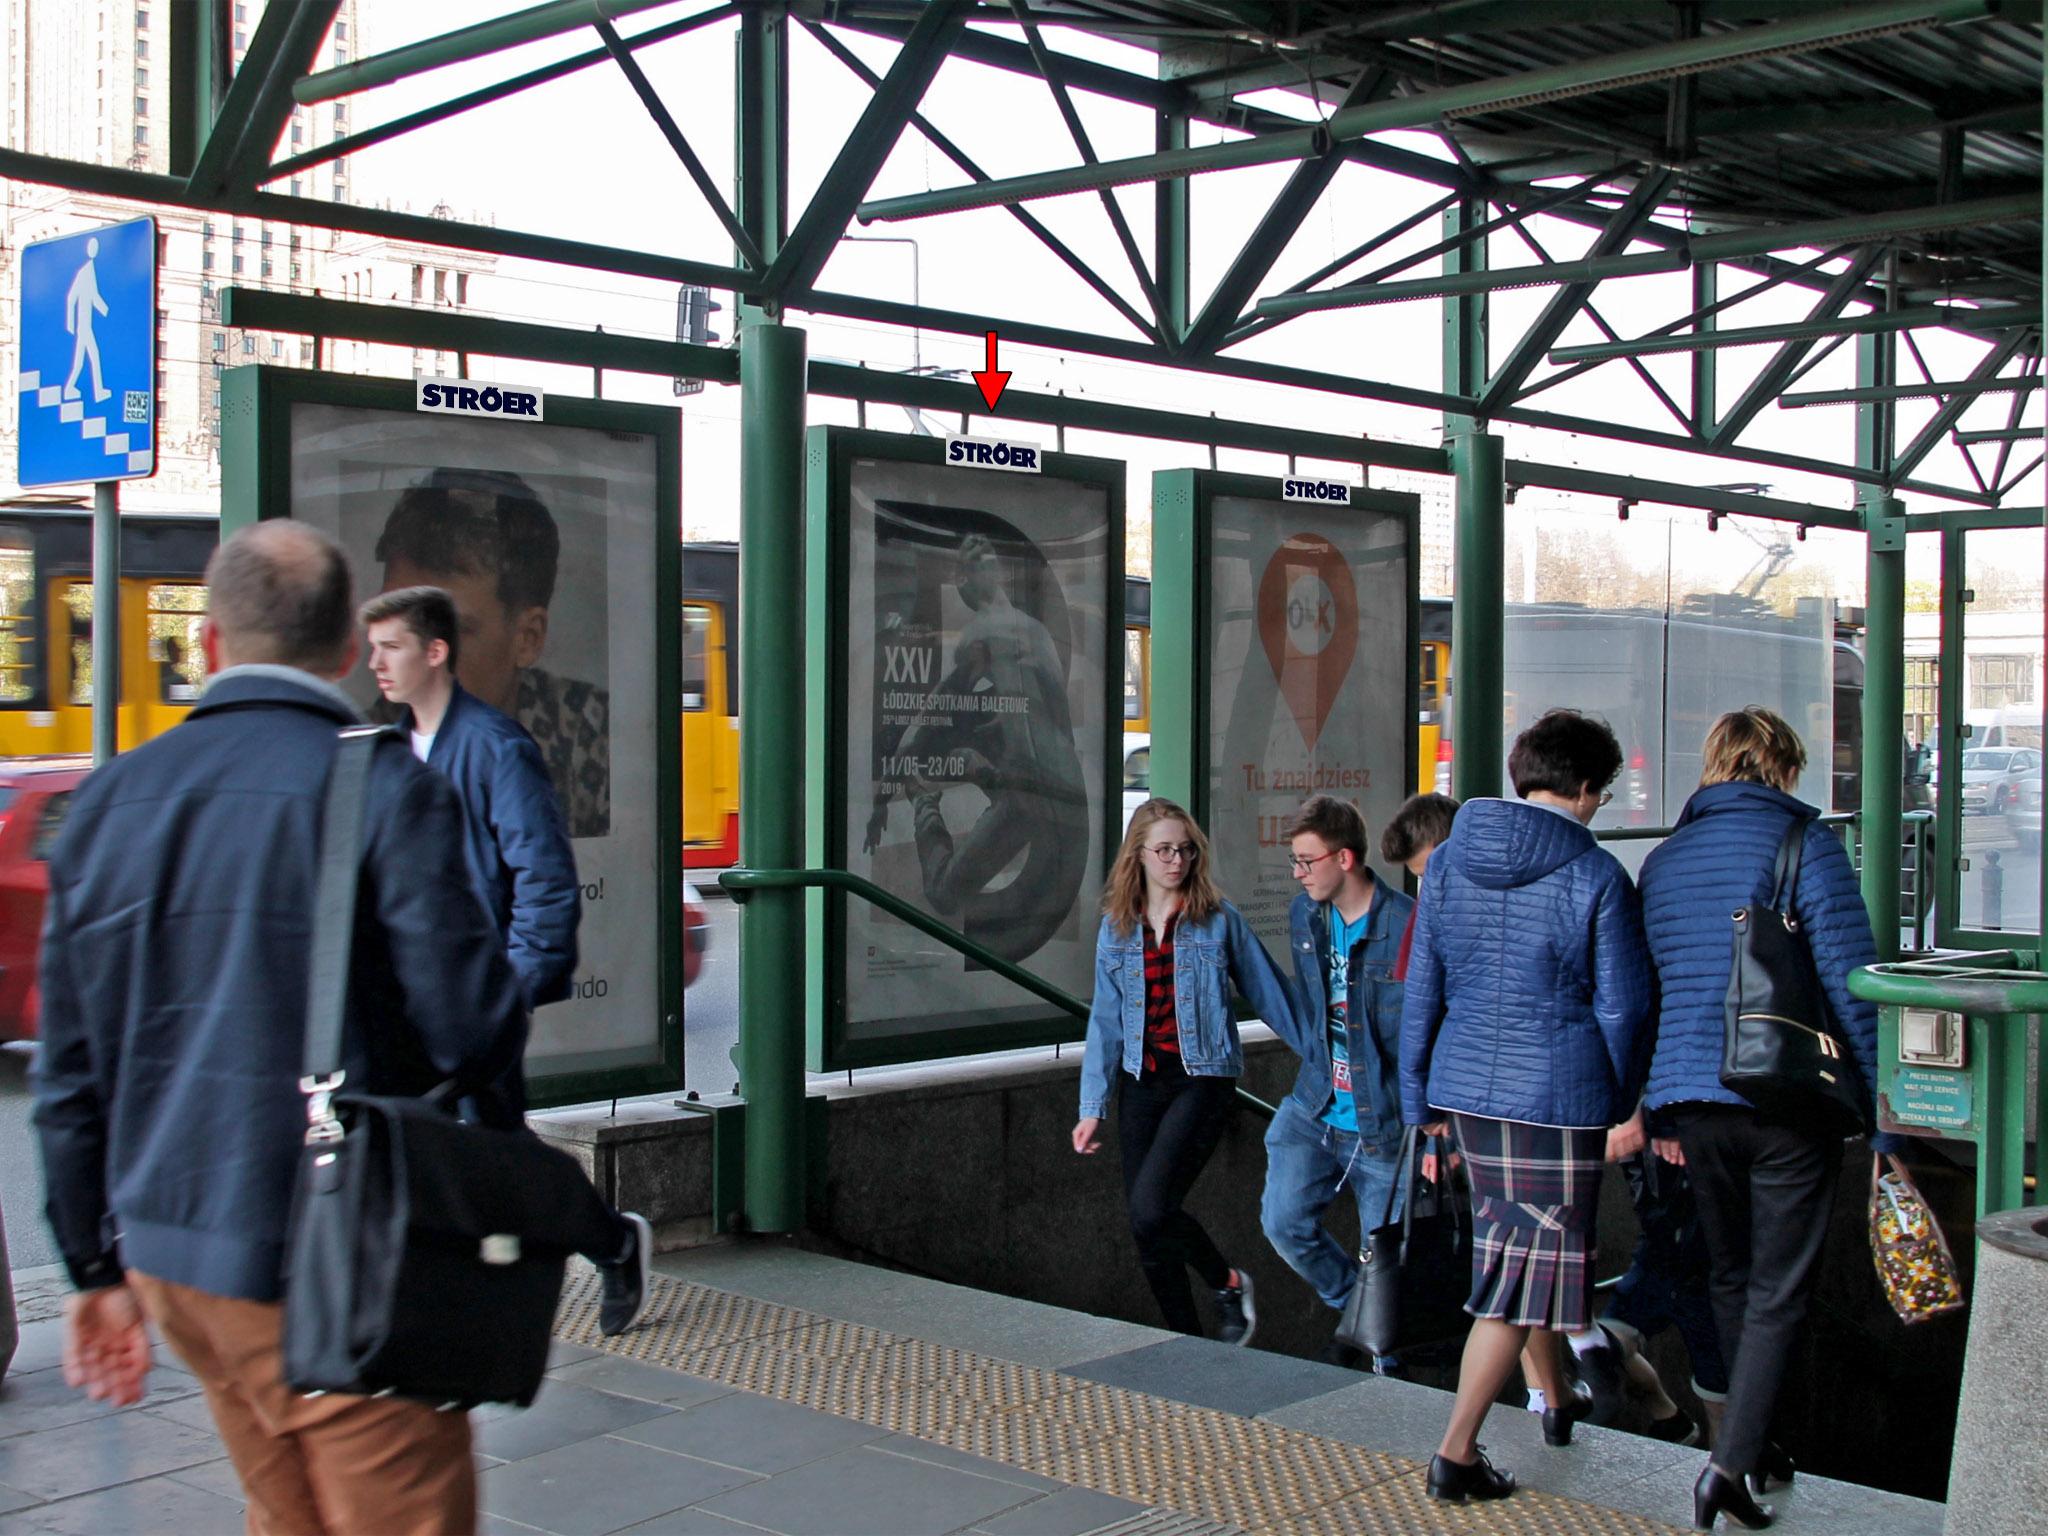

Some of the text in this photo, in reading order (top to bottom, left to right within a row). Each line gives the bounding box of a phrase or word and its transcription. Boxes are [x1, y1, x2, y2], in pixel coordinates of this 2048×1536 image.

[422, 383, 539, 417] STRÖER
[949, 440, 1037, 468] STRÖER
[1285, 480, 1348, 501] STRÖER
[883, 645, 933, 684] XXV
[882, 689, 1030, 713] ŁÓDZKIE SPOTKANIA BALETOWE
[1243, 762, 1371, 794] Tu znajdziesz
